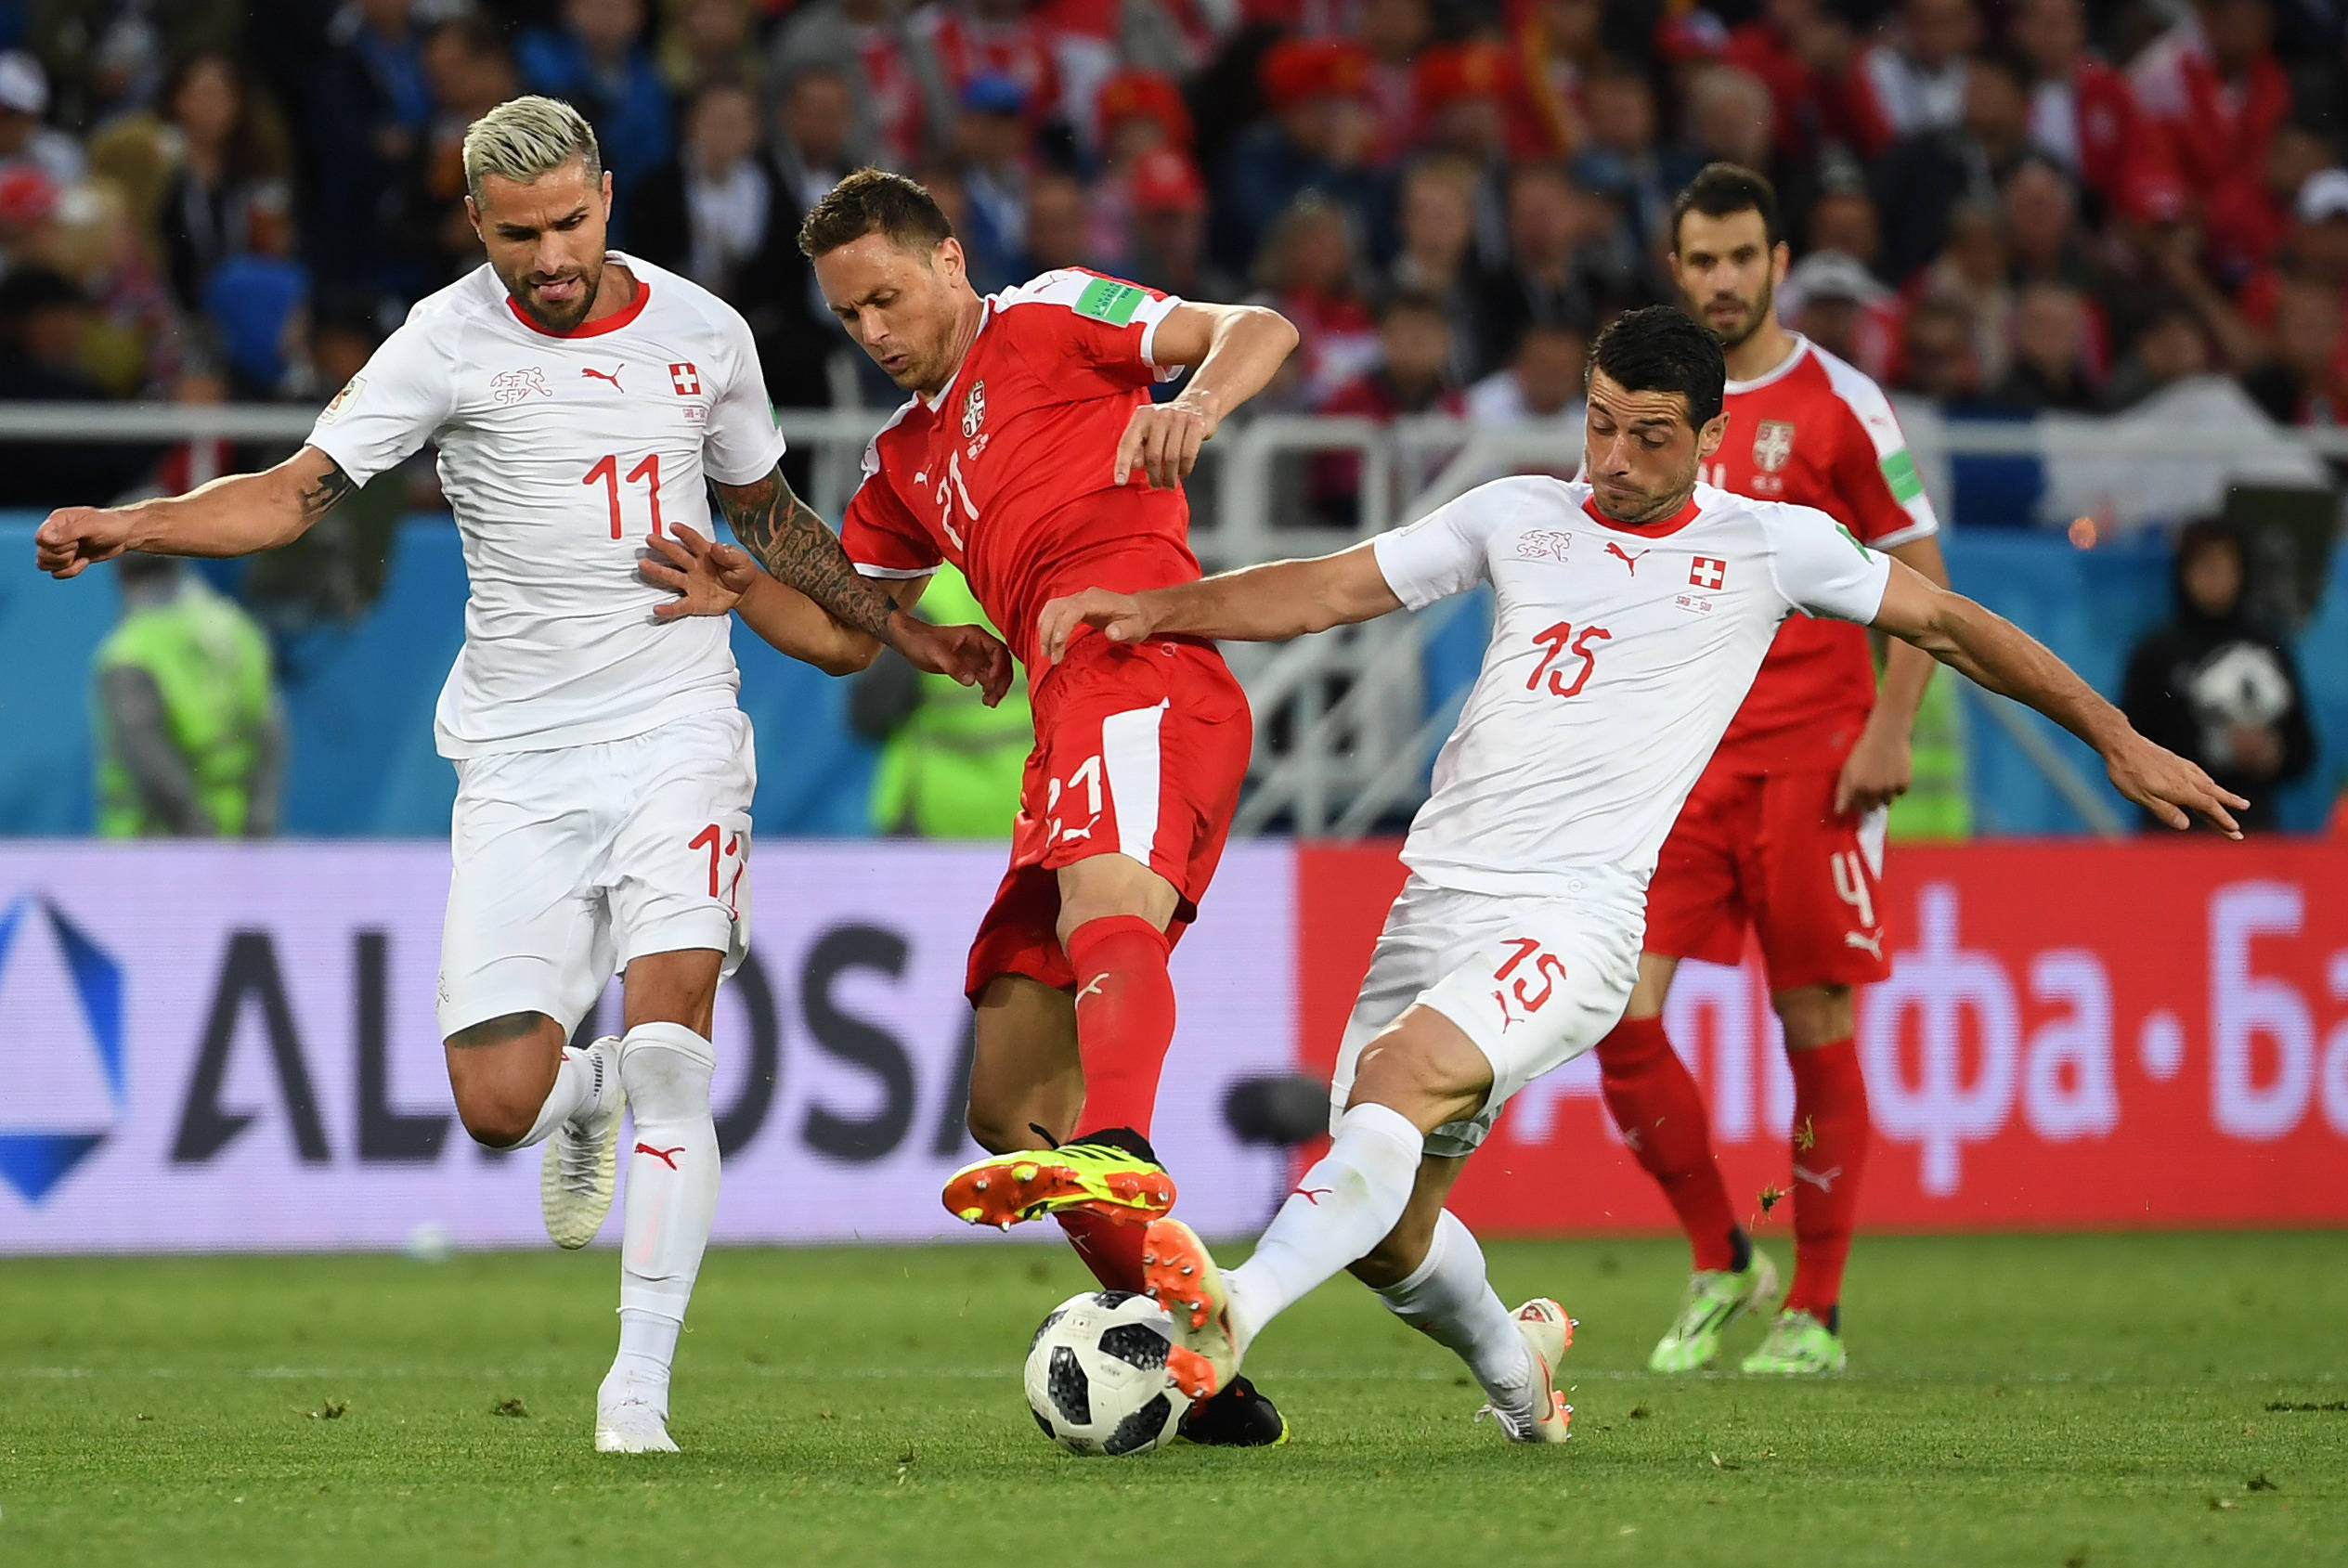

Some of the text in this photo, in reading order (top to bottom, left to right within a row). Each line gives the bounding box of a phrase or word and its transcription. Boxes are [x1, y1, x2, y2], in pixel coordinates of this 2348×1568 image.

[582, 454, 662, 539] 11
[936, 448, 979, 551] 21
[1526, 621, 1612, 698] 15
[1830, 849, 1875, 928] 4
[1494, 937, 1566, 1013] 15
